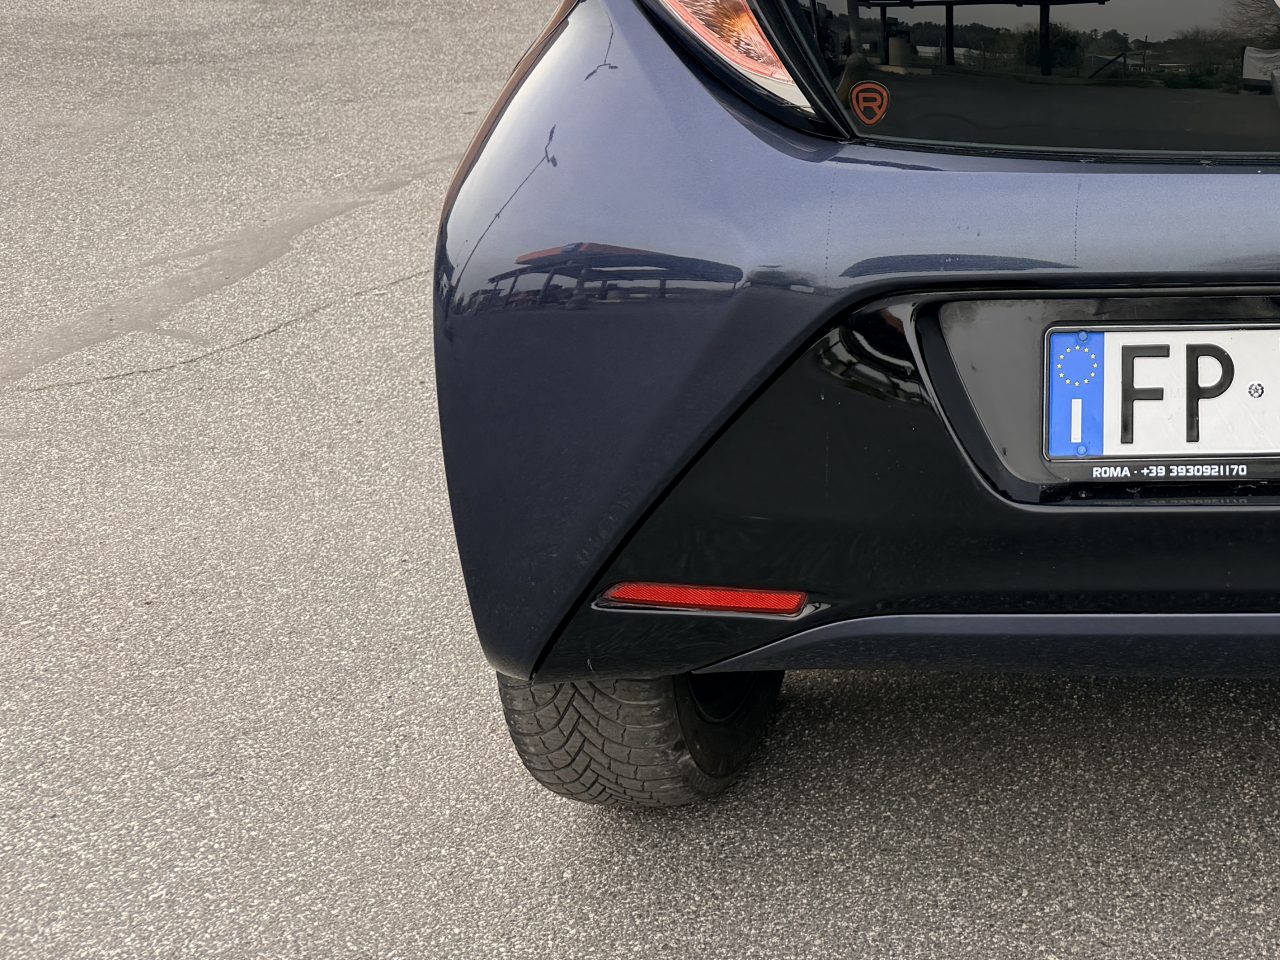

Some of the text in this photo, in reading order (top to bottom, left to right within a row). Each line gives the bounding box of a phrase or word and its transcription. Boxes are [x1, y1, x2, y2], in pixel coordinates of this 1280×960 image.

[1120, 344, 1235, 445] FP
[1092, 466, 1131, 478] ROMA
[1141, 465, 1166, 477] +39
[1169, 464, 1248, 477] 3930921170
